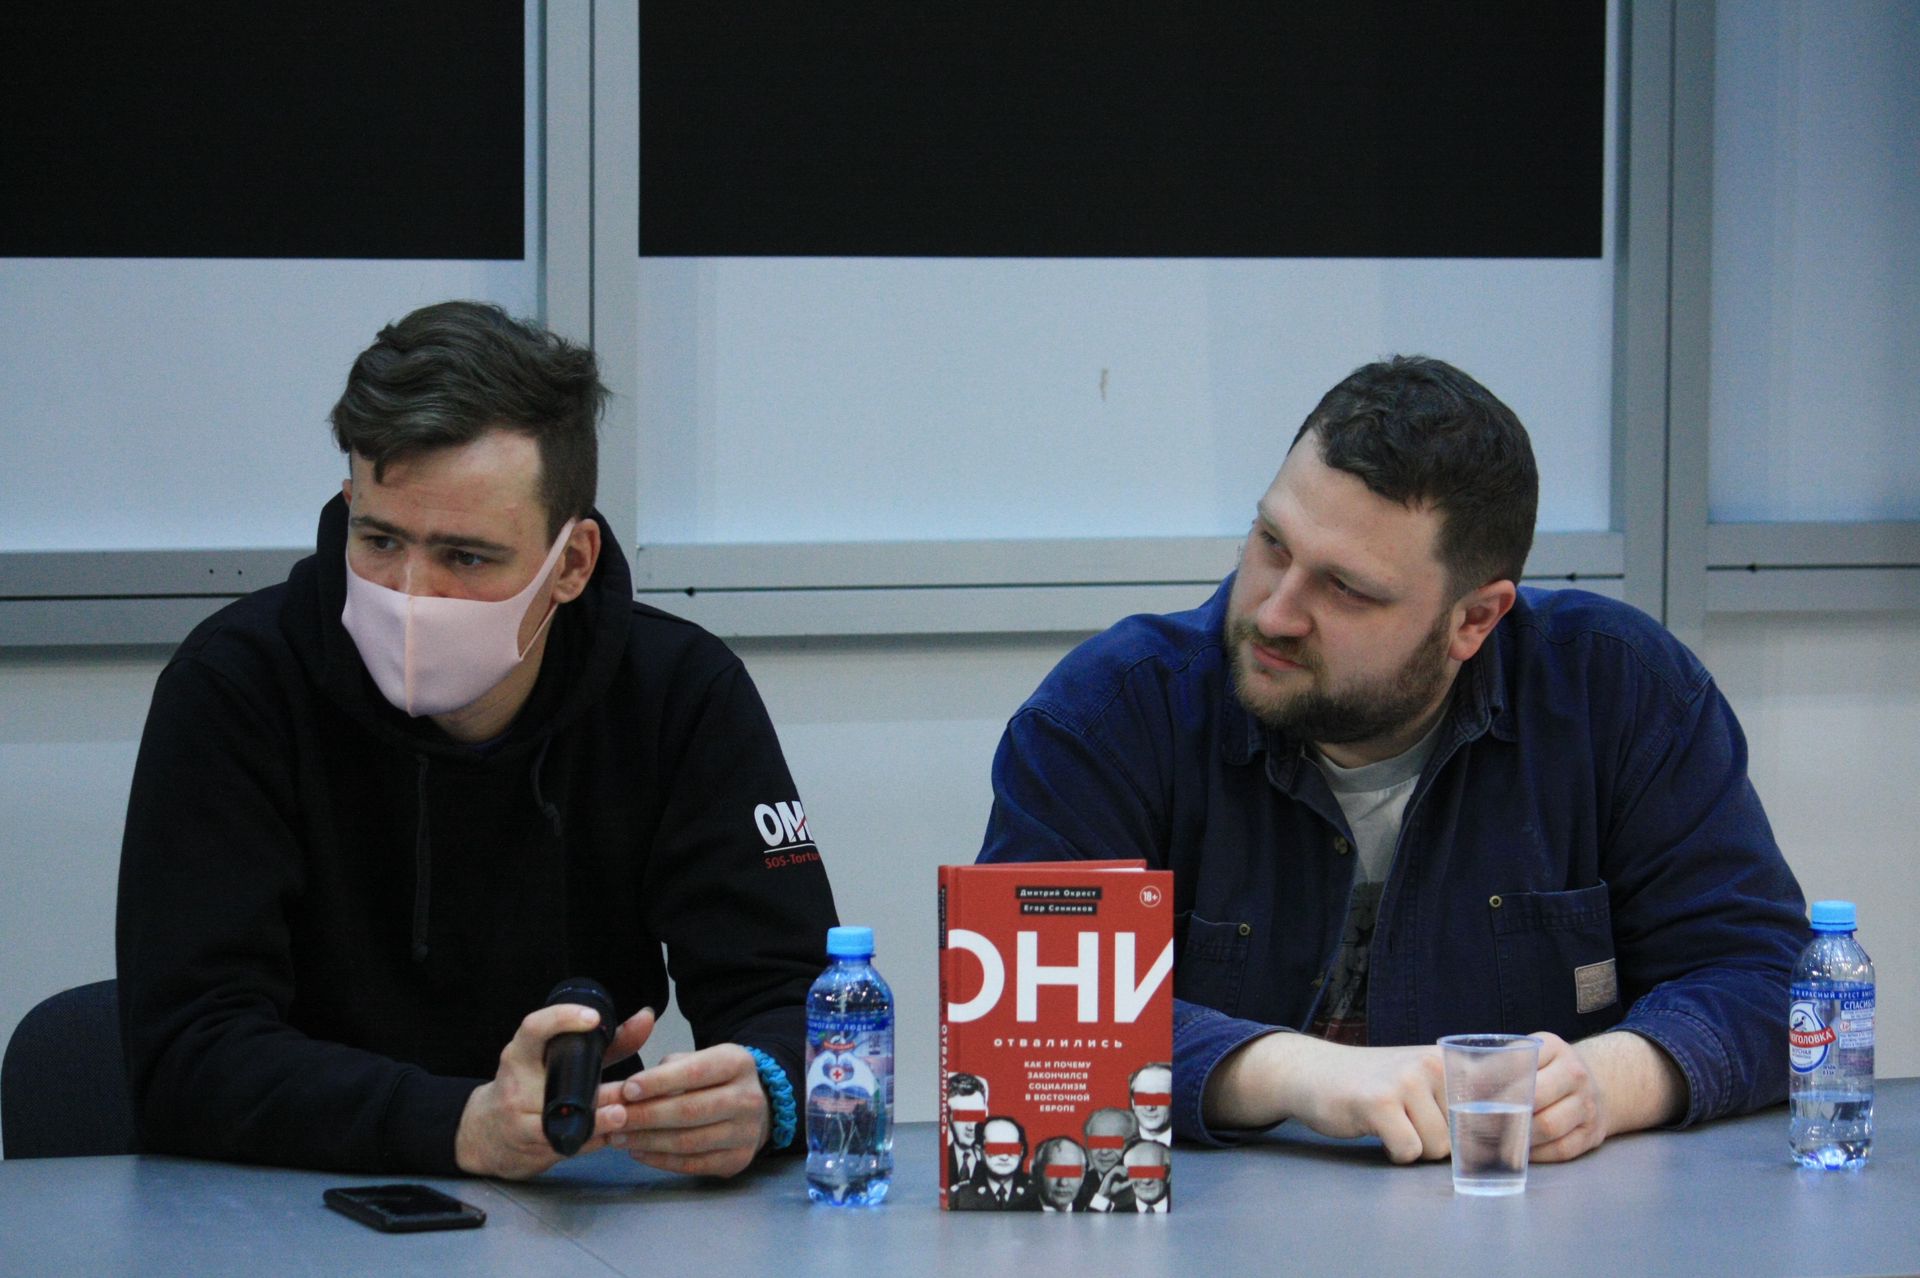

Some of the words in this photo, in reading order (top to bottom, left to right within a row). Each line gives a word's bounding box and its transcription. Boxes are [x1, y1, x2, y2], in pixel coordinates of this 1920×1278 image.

[1020, 888, 1060, 898] Дмитрий
[1063, 888, 1097, 898] Окрест
[1142, 889, 1158, 903] 18+
[1023, 904, 1045, 913] Егор
[1048, 904, 1093, 912] Сенников
[948, 929, 1174, 1023] ОНИ
[1801, 990, 1836, 999] КРАСНЫЙ
[1839, 991, 1860, 999] КРЕСТ
[1024, 1061, 1042, 1069] КАК
[1045, 1061, 1051, 1069] И
[1053, 1061, 1092, 1069] ПОЧЕМУ
[1028, 1082, 1087, 1090] СОЦИАЛИЗМ
[1025, 1093, 1031, 1101] В
[1033, 1093, 1090, 1101] ВОСТОЧНОЙ
[1039, 1104, 1076, 1113] ЕВРОПЕ
